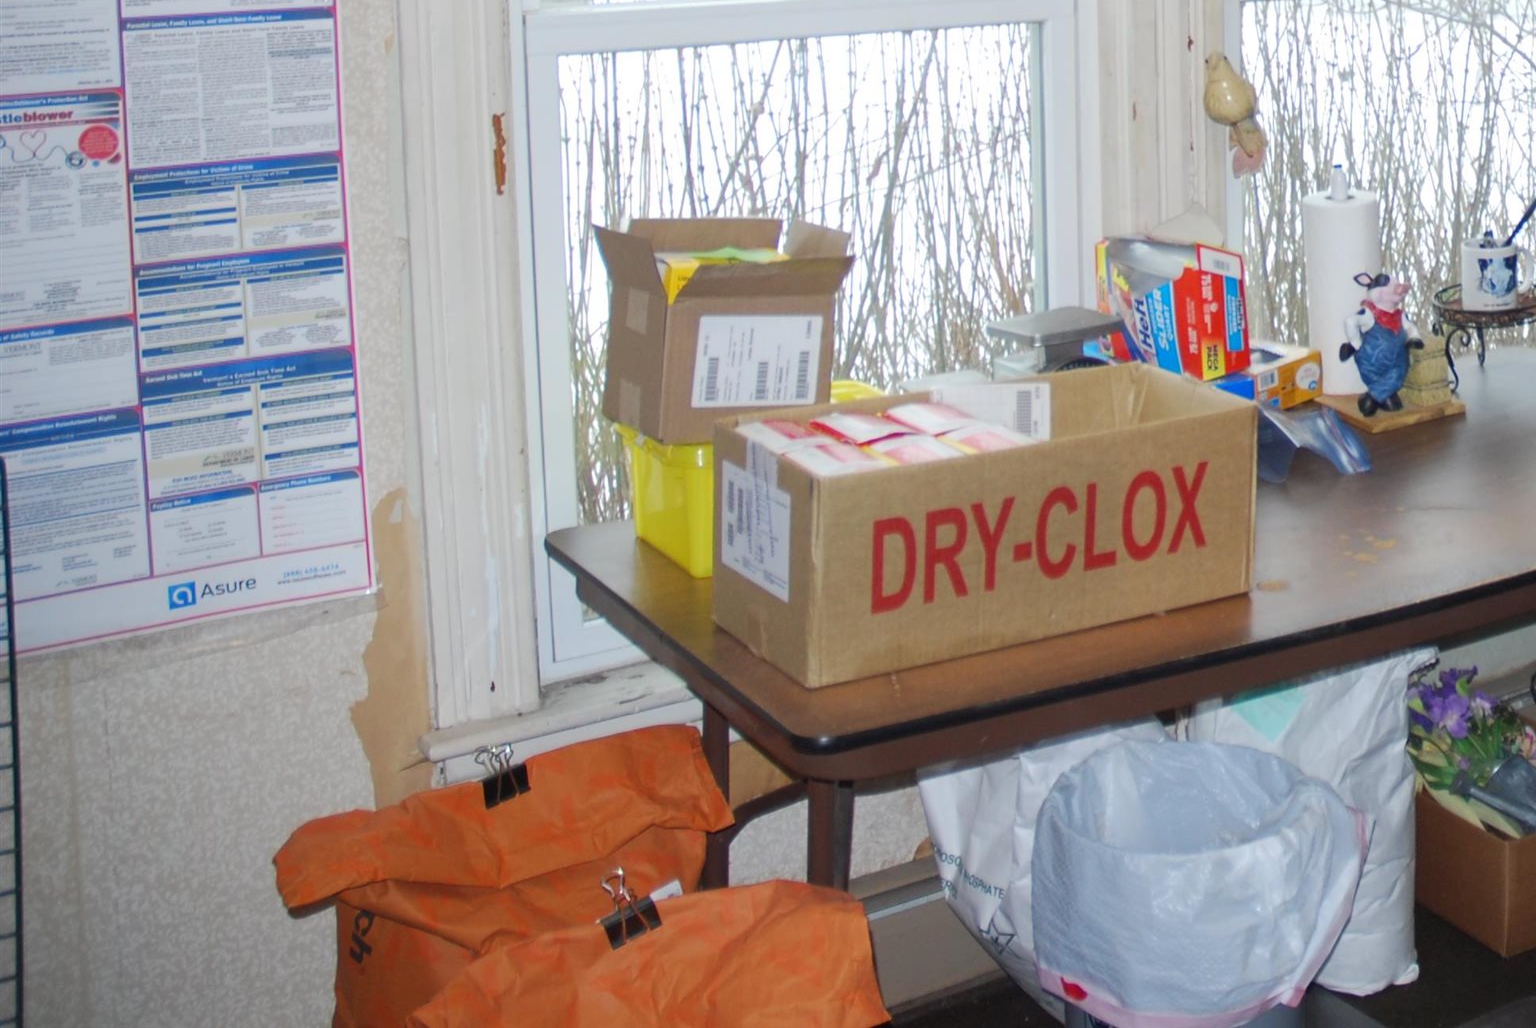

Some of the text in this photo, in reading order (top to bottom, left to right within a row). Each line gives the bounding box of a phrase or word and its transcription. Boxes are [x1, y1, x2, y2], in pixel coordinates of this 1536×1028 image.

[0, 110, 74, 124] tleblower
[1153, 289, 1169, 352] SLIDER
[1163, 304, 1174, 342] QUART
[870, 461, 1209, 615] DRY-CLOX
[201, 576, 257, 598] Asure
